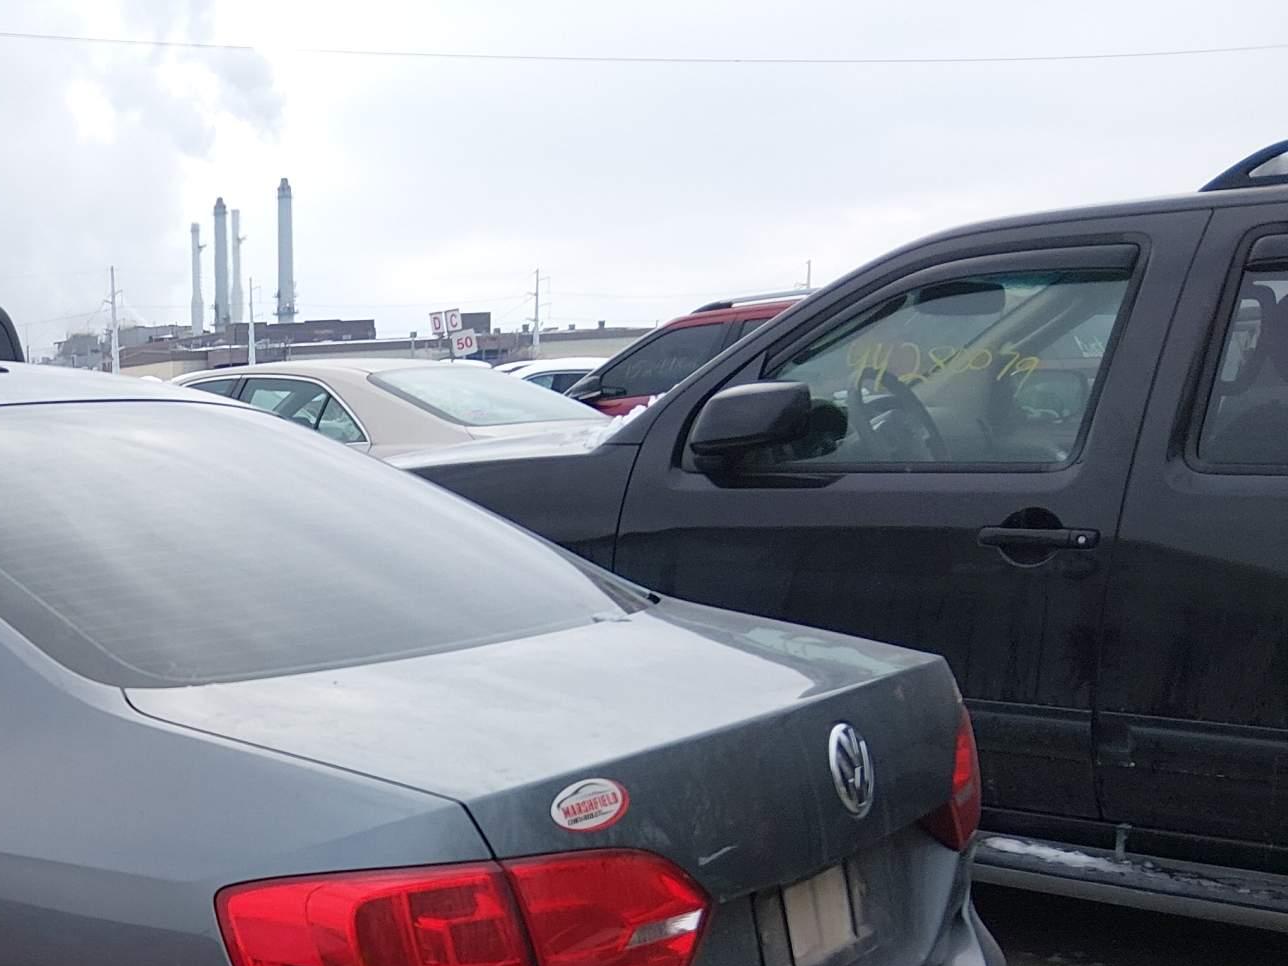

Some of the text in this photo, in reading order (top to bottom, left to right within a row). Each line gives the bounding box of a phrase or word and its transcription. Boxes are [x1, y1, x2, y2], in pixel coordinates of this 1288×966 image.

[432, 313, 458, 330] D C
[456, 336, 473, 350] 50
[561, 792, 619, 818] MARSHFIELD
